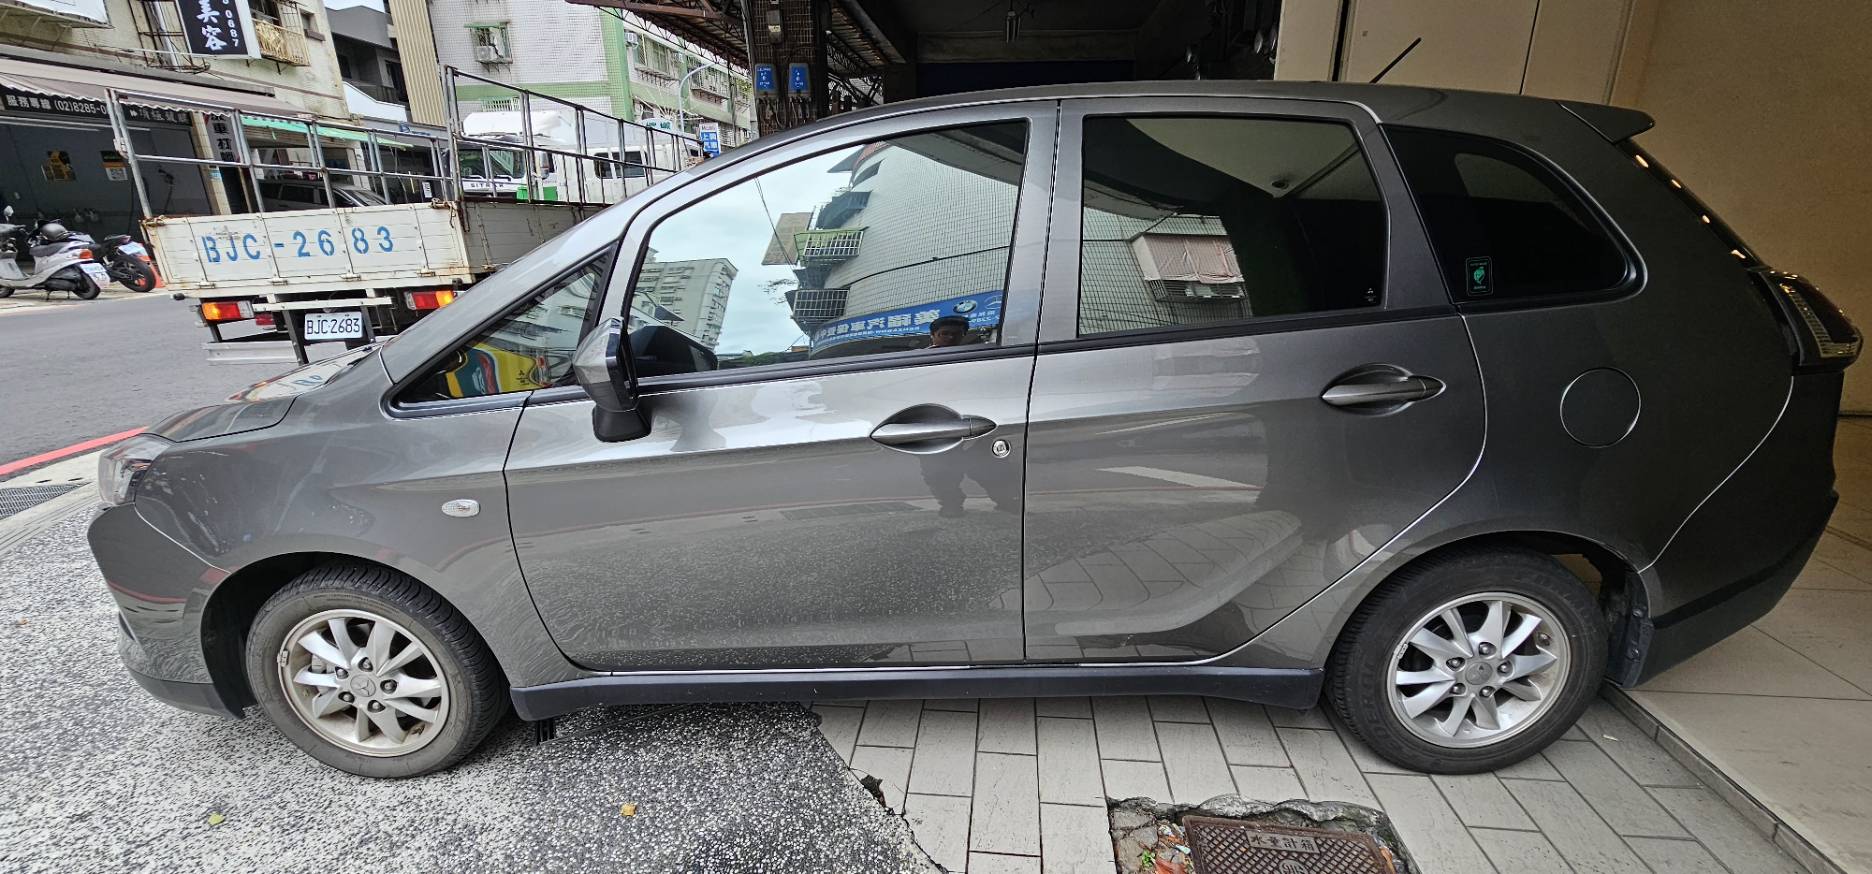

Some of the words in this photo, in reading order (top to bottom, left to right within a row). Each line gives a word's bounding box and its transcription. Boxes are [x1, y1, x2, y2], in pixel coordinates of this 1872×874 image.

[196, 0, 228, 51] 美容
[6, 94, 51, 110] 服務專線
